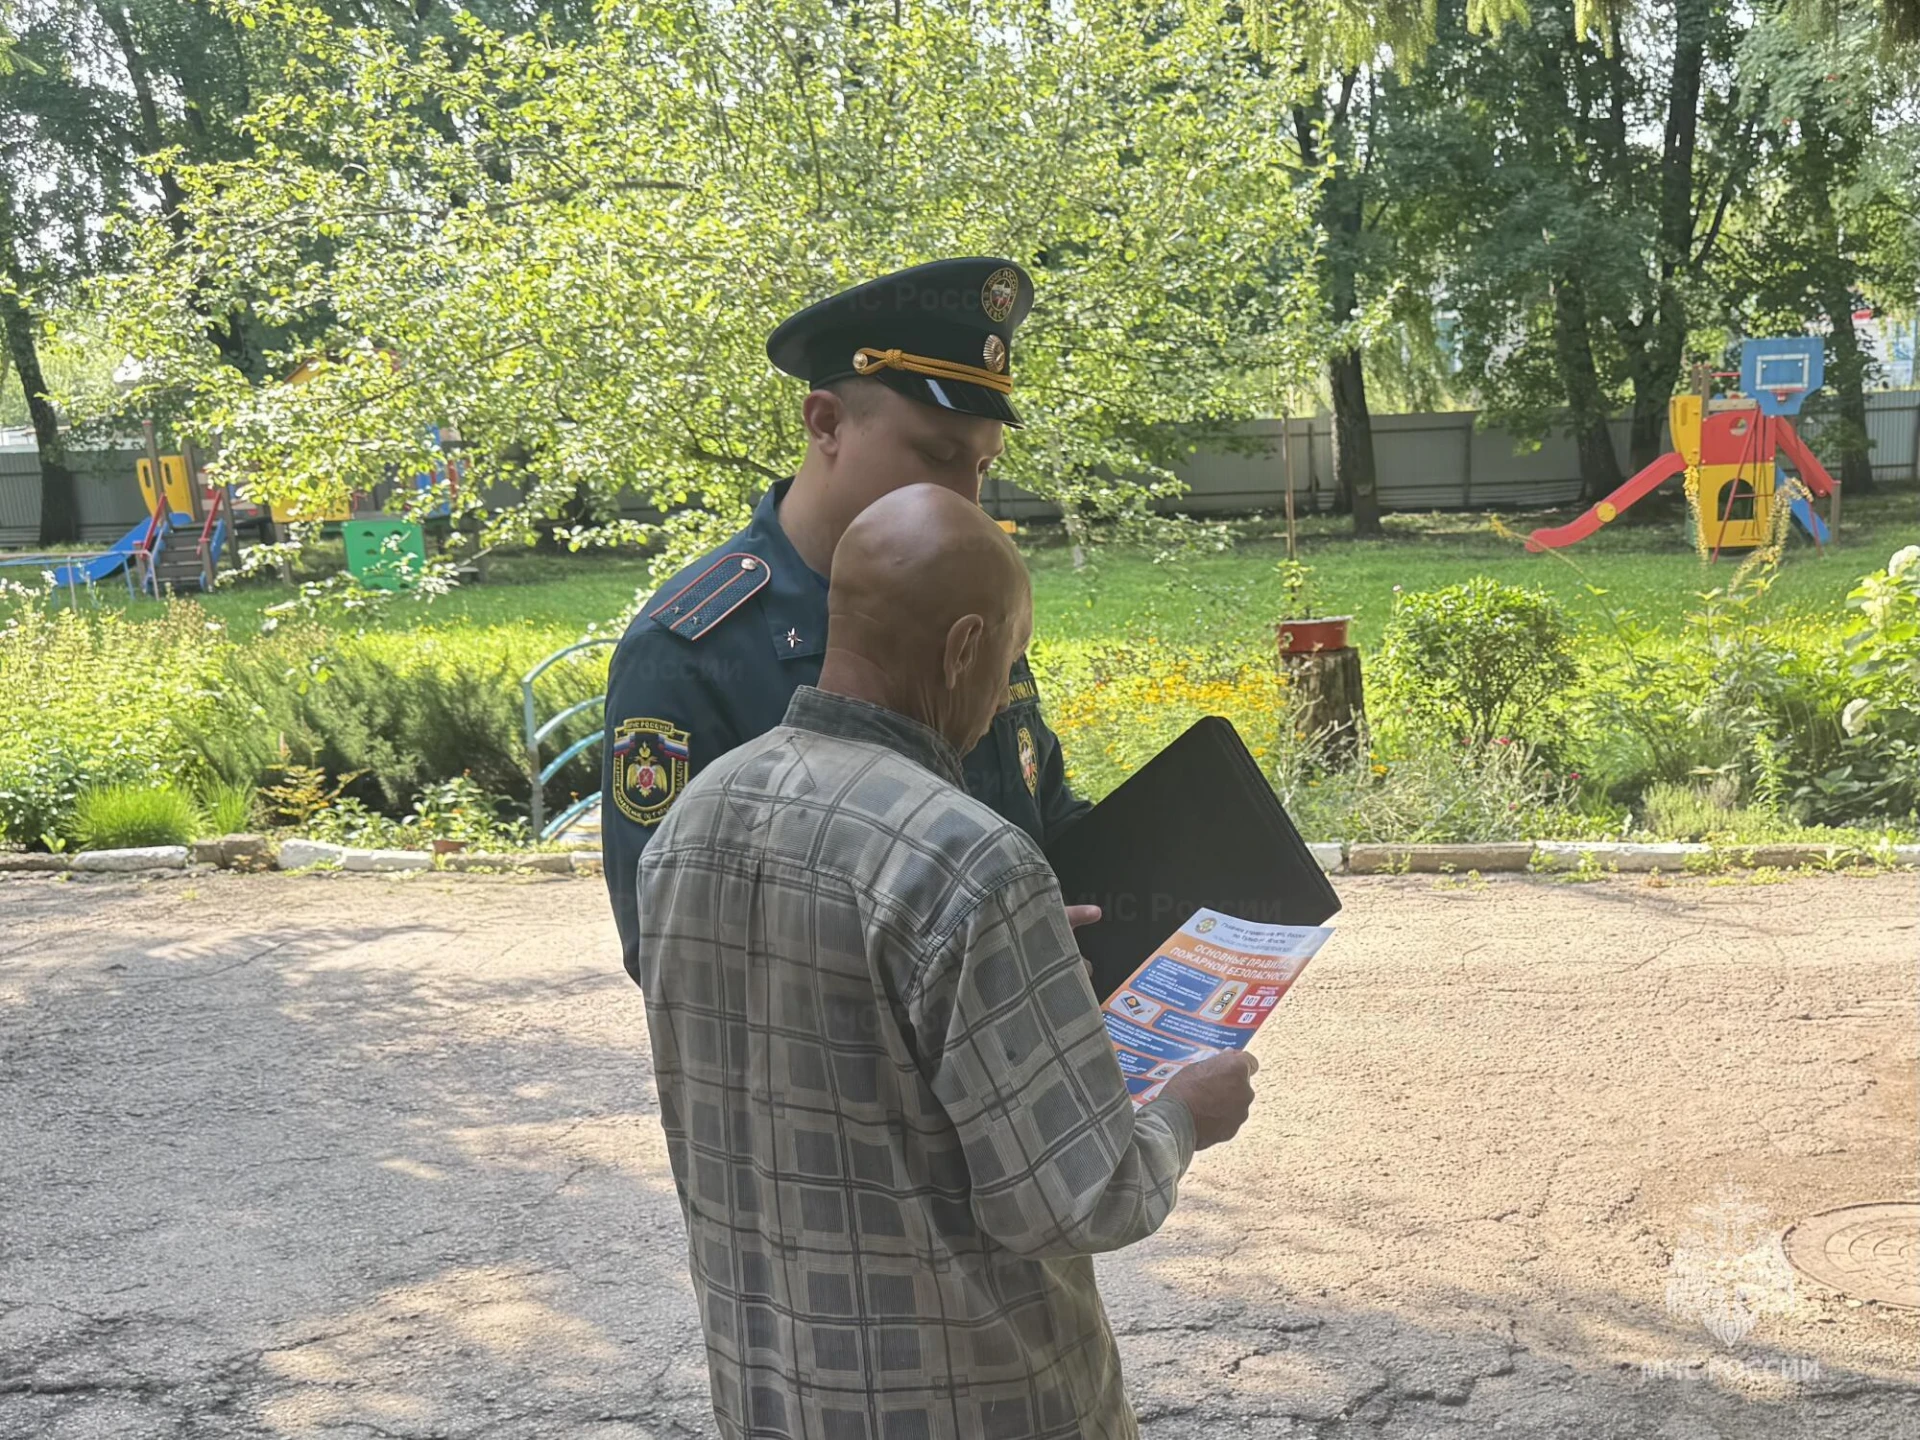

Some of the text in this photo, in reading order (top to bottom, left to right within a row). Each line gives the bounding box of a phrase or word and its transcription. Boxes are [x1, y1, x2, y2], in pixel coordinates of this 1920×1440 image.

[1169, 946, 1228, 974] ПОЖАРНОЙ
[1225, 966, 1294, 981] БЕЗОПАСНОСТИ
[1194, 944, 1249, 967] ОСНОВНЫЕ
